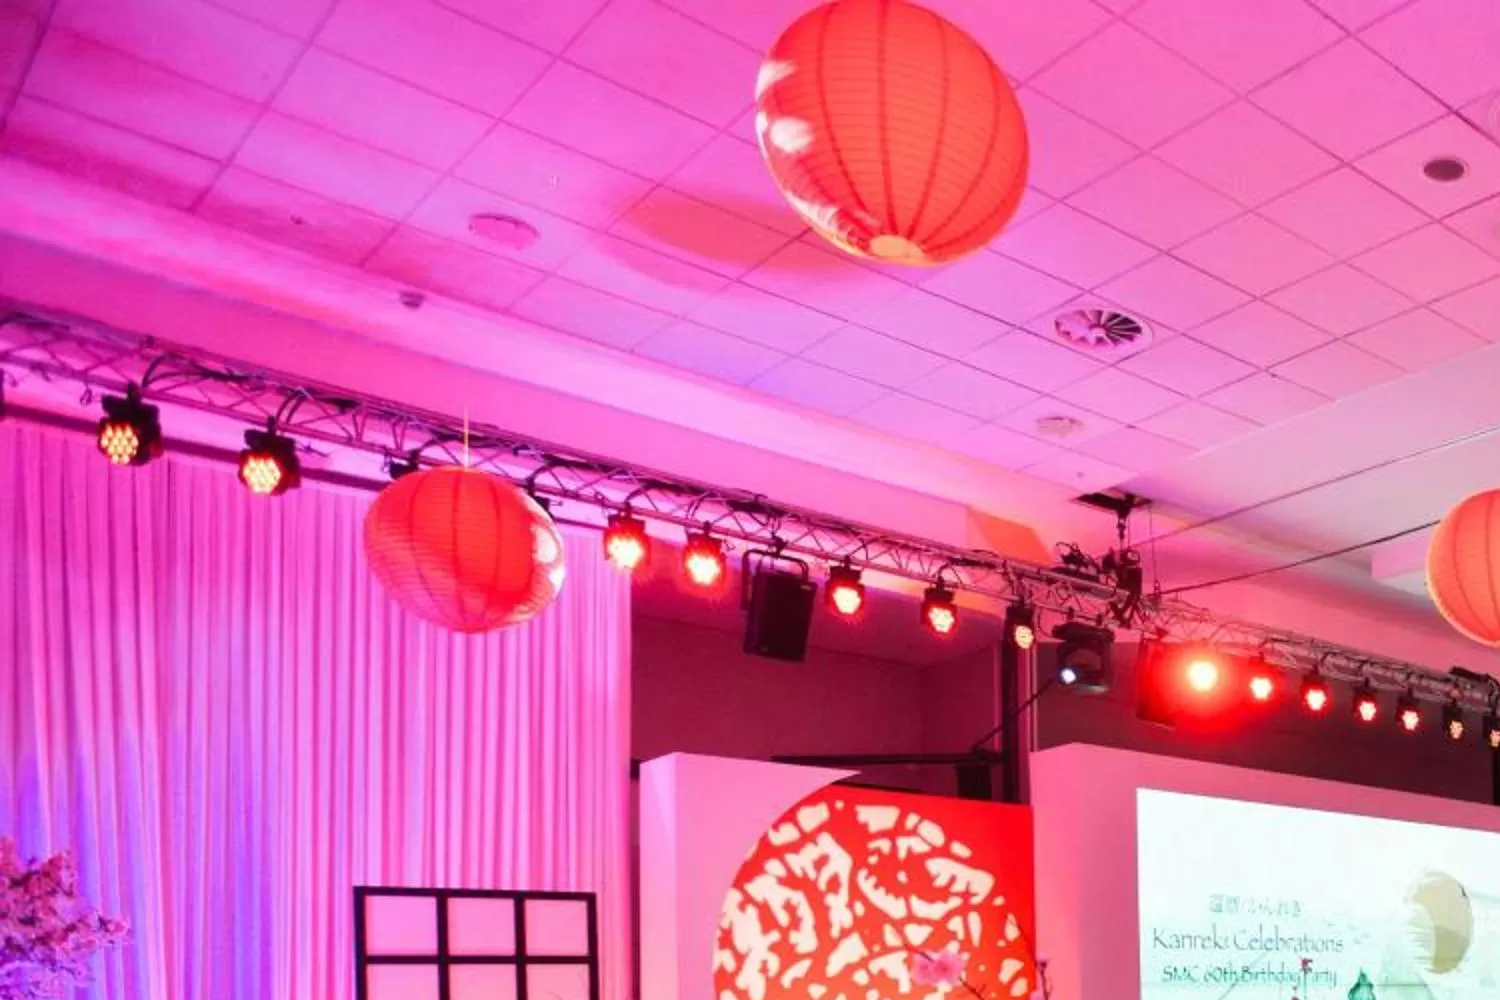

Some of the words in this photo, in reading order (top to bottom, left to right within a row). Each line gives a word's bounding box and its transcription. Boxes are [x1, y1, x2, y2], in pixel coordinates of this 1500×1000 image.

[1233, 924, 1345, 953] Celebrations
[1162, 964, 1199, 983] SMC
[1302, 959, 1337, 990] arty
